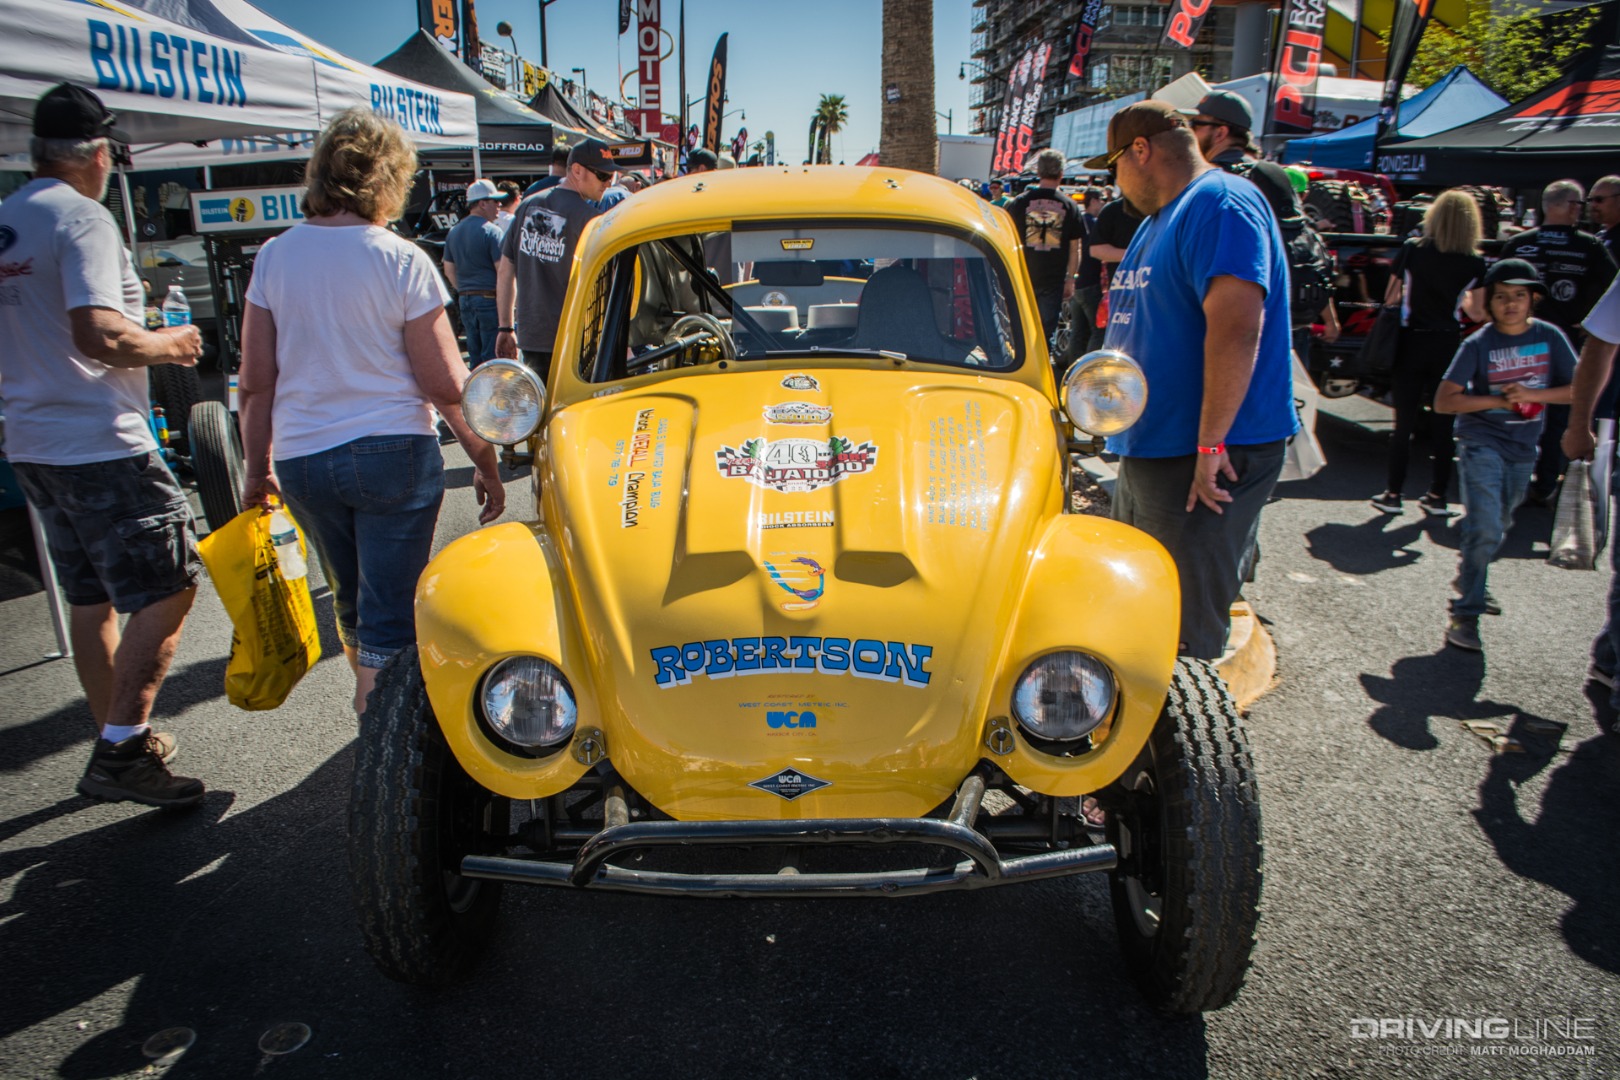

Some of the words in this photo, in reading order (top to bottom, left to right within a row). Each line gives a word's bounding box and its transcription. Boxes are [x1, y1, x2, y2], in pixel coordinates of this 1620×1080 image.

[85, 18, 248, 108] BILSTEIN
[638, 0, 660, 138] MOTEL
[1069, 23, 1093, 78] PCI
[1274, 29, 1323, 130] PCI
[1013, 124, 1033, 173] PCI
[619, 472, 645, 528] Champion
[650, 491, 661, 508] BUG
[652, 470, 662, 488] BAJA
[758, 510, 834, 524] BILSTEIN
[650, 635, 934, 689] ROBERTSON
[766, 710, 817, 729] WCM
[778, 775, 802, 784] WCM
